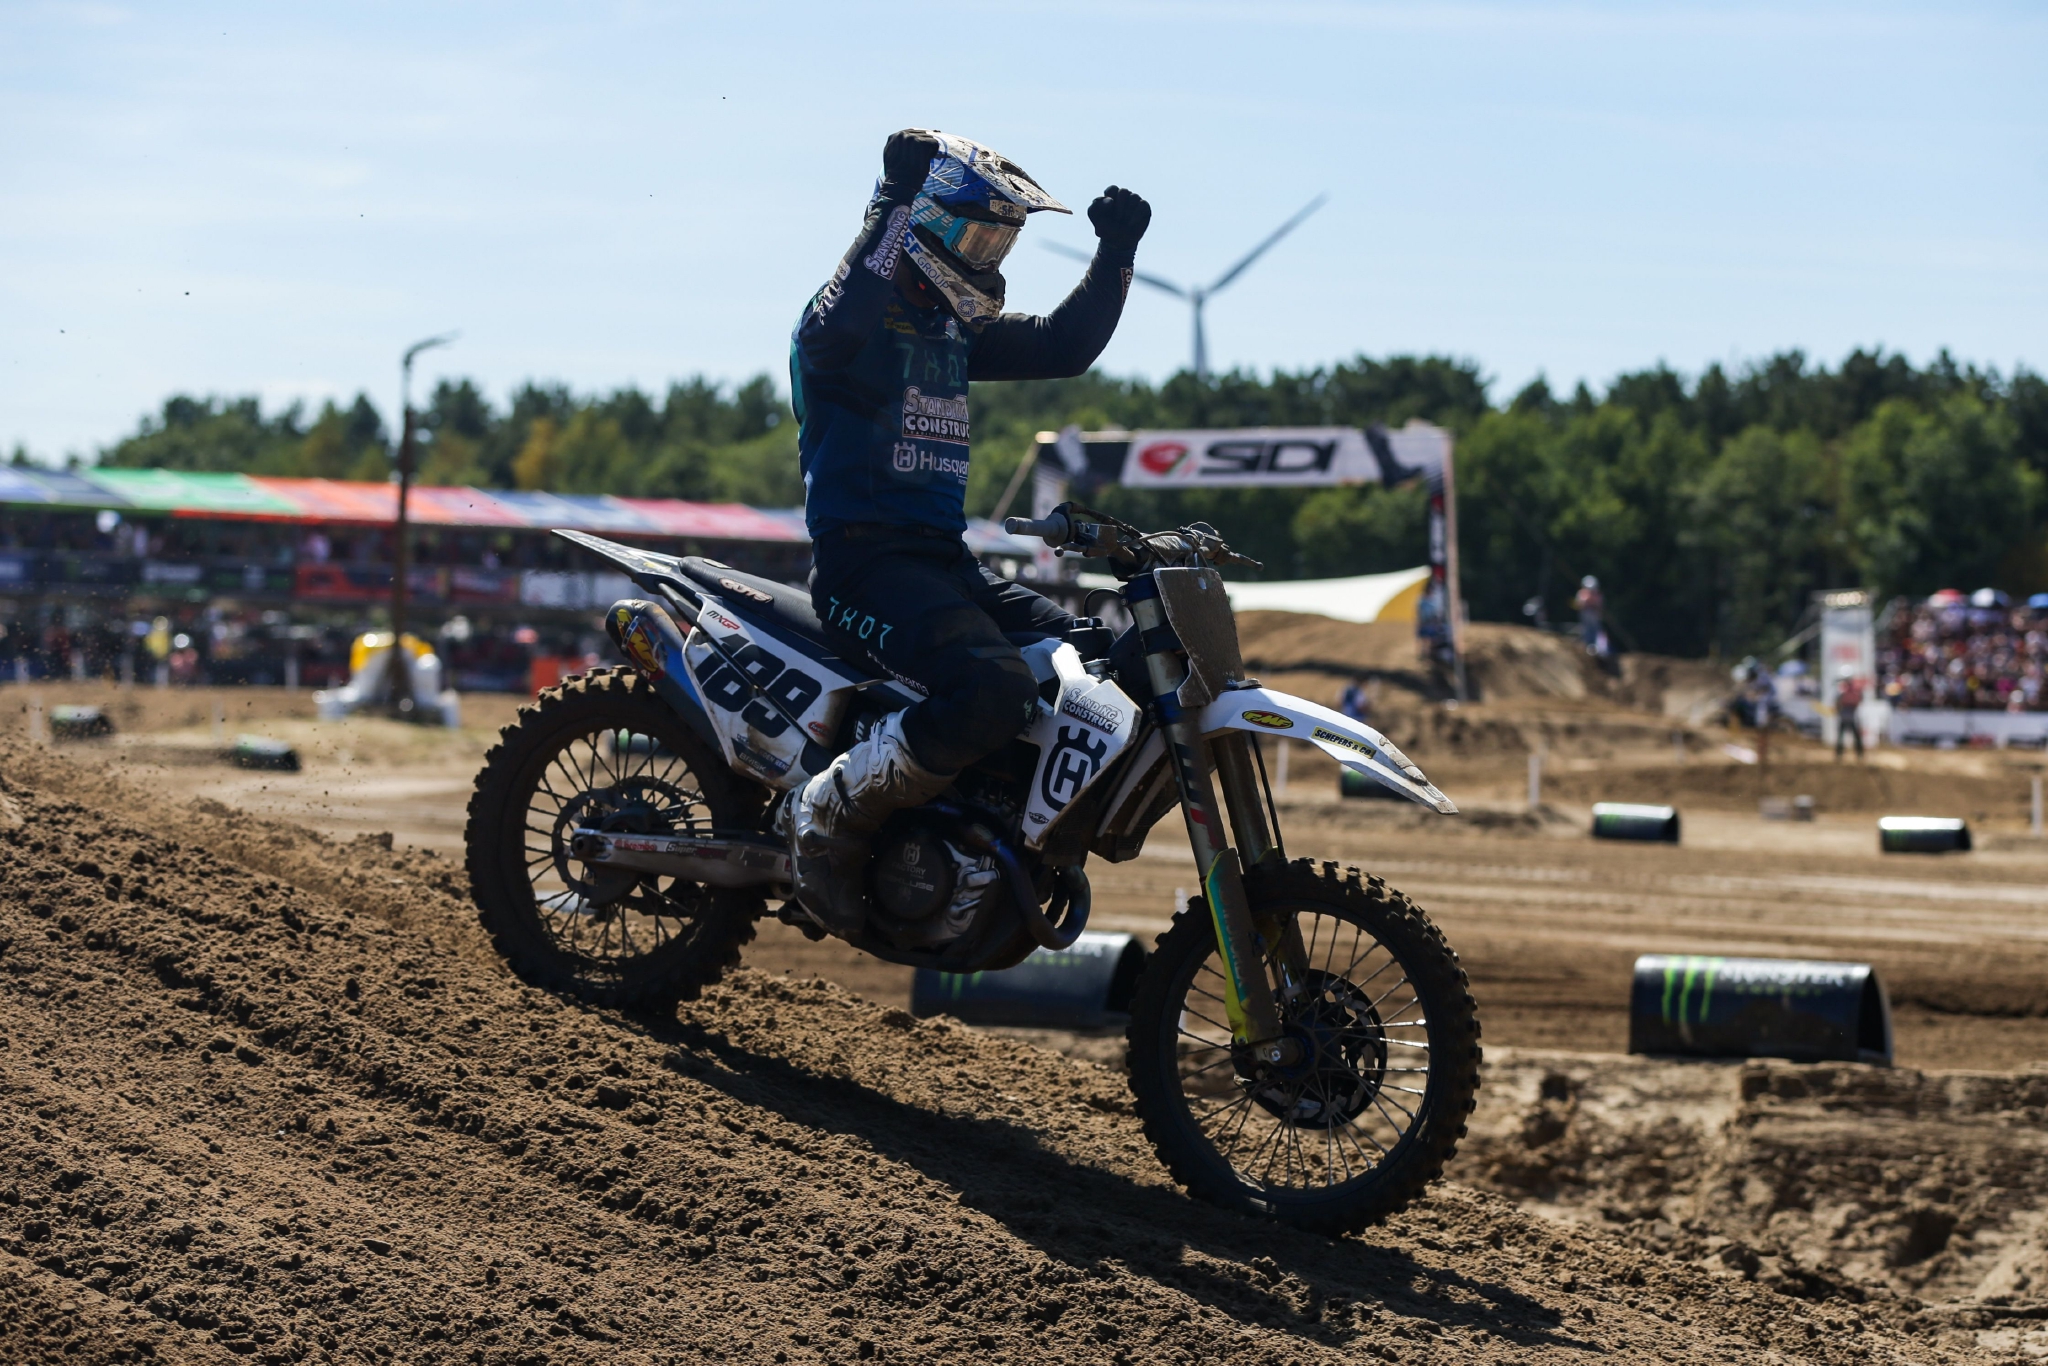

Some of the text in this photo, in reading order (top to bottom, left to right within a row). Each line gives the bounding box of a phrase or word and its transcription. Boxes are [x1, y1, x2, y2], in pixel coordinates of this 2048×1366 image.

[863, 212, 907, 272] STANDING
[902, 230, 951, 291] SF GROUP
[1199, 440, 1338, 474] SIDI
[719, 577, 774, 603] GUTS
[706, 610, 741, 631] MXGP
[1062, 700, 1120, 735] CONSTRUCT
[1066, 687, 1119, 721] STANDING
[1244, 711, 1293, 728] FMF
[1314, 729, 1353, 749] SCHEPERS
[738, 751, 768, 773] BRISK
